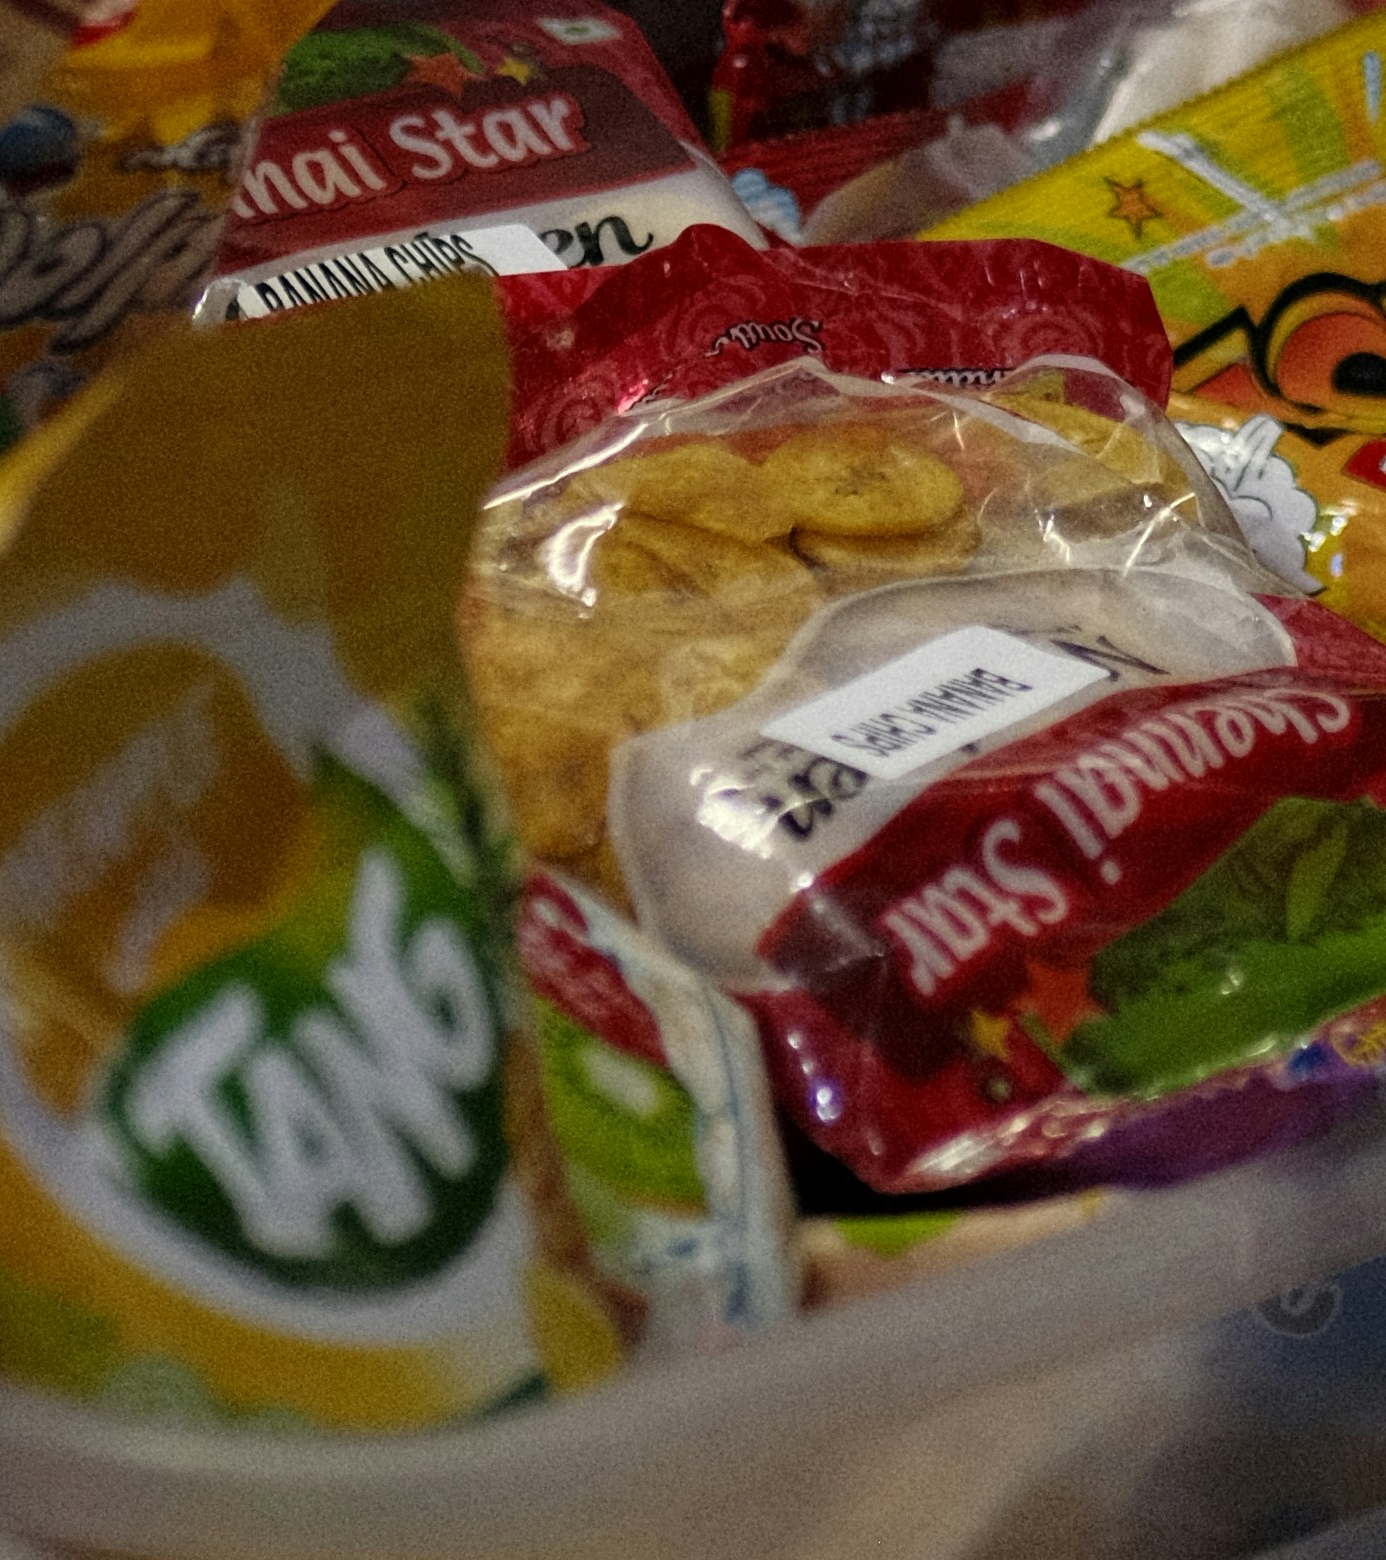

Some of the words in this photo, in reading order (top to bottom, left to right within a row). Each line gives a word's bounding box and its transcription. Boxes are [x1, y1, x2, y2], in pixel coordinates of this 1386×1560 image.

[388, 96, 575, 182] Star
[257, 250, 385, 313] BANANA
[831, 712, 937, 759] CHIPS
[901, 667, 1034, 726] BANANA
[1033, 687, 1355, 886] Chennai
[877, 809, 1075, 999] Star
[125, 844, 497, 1260] TANG
